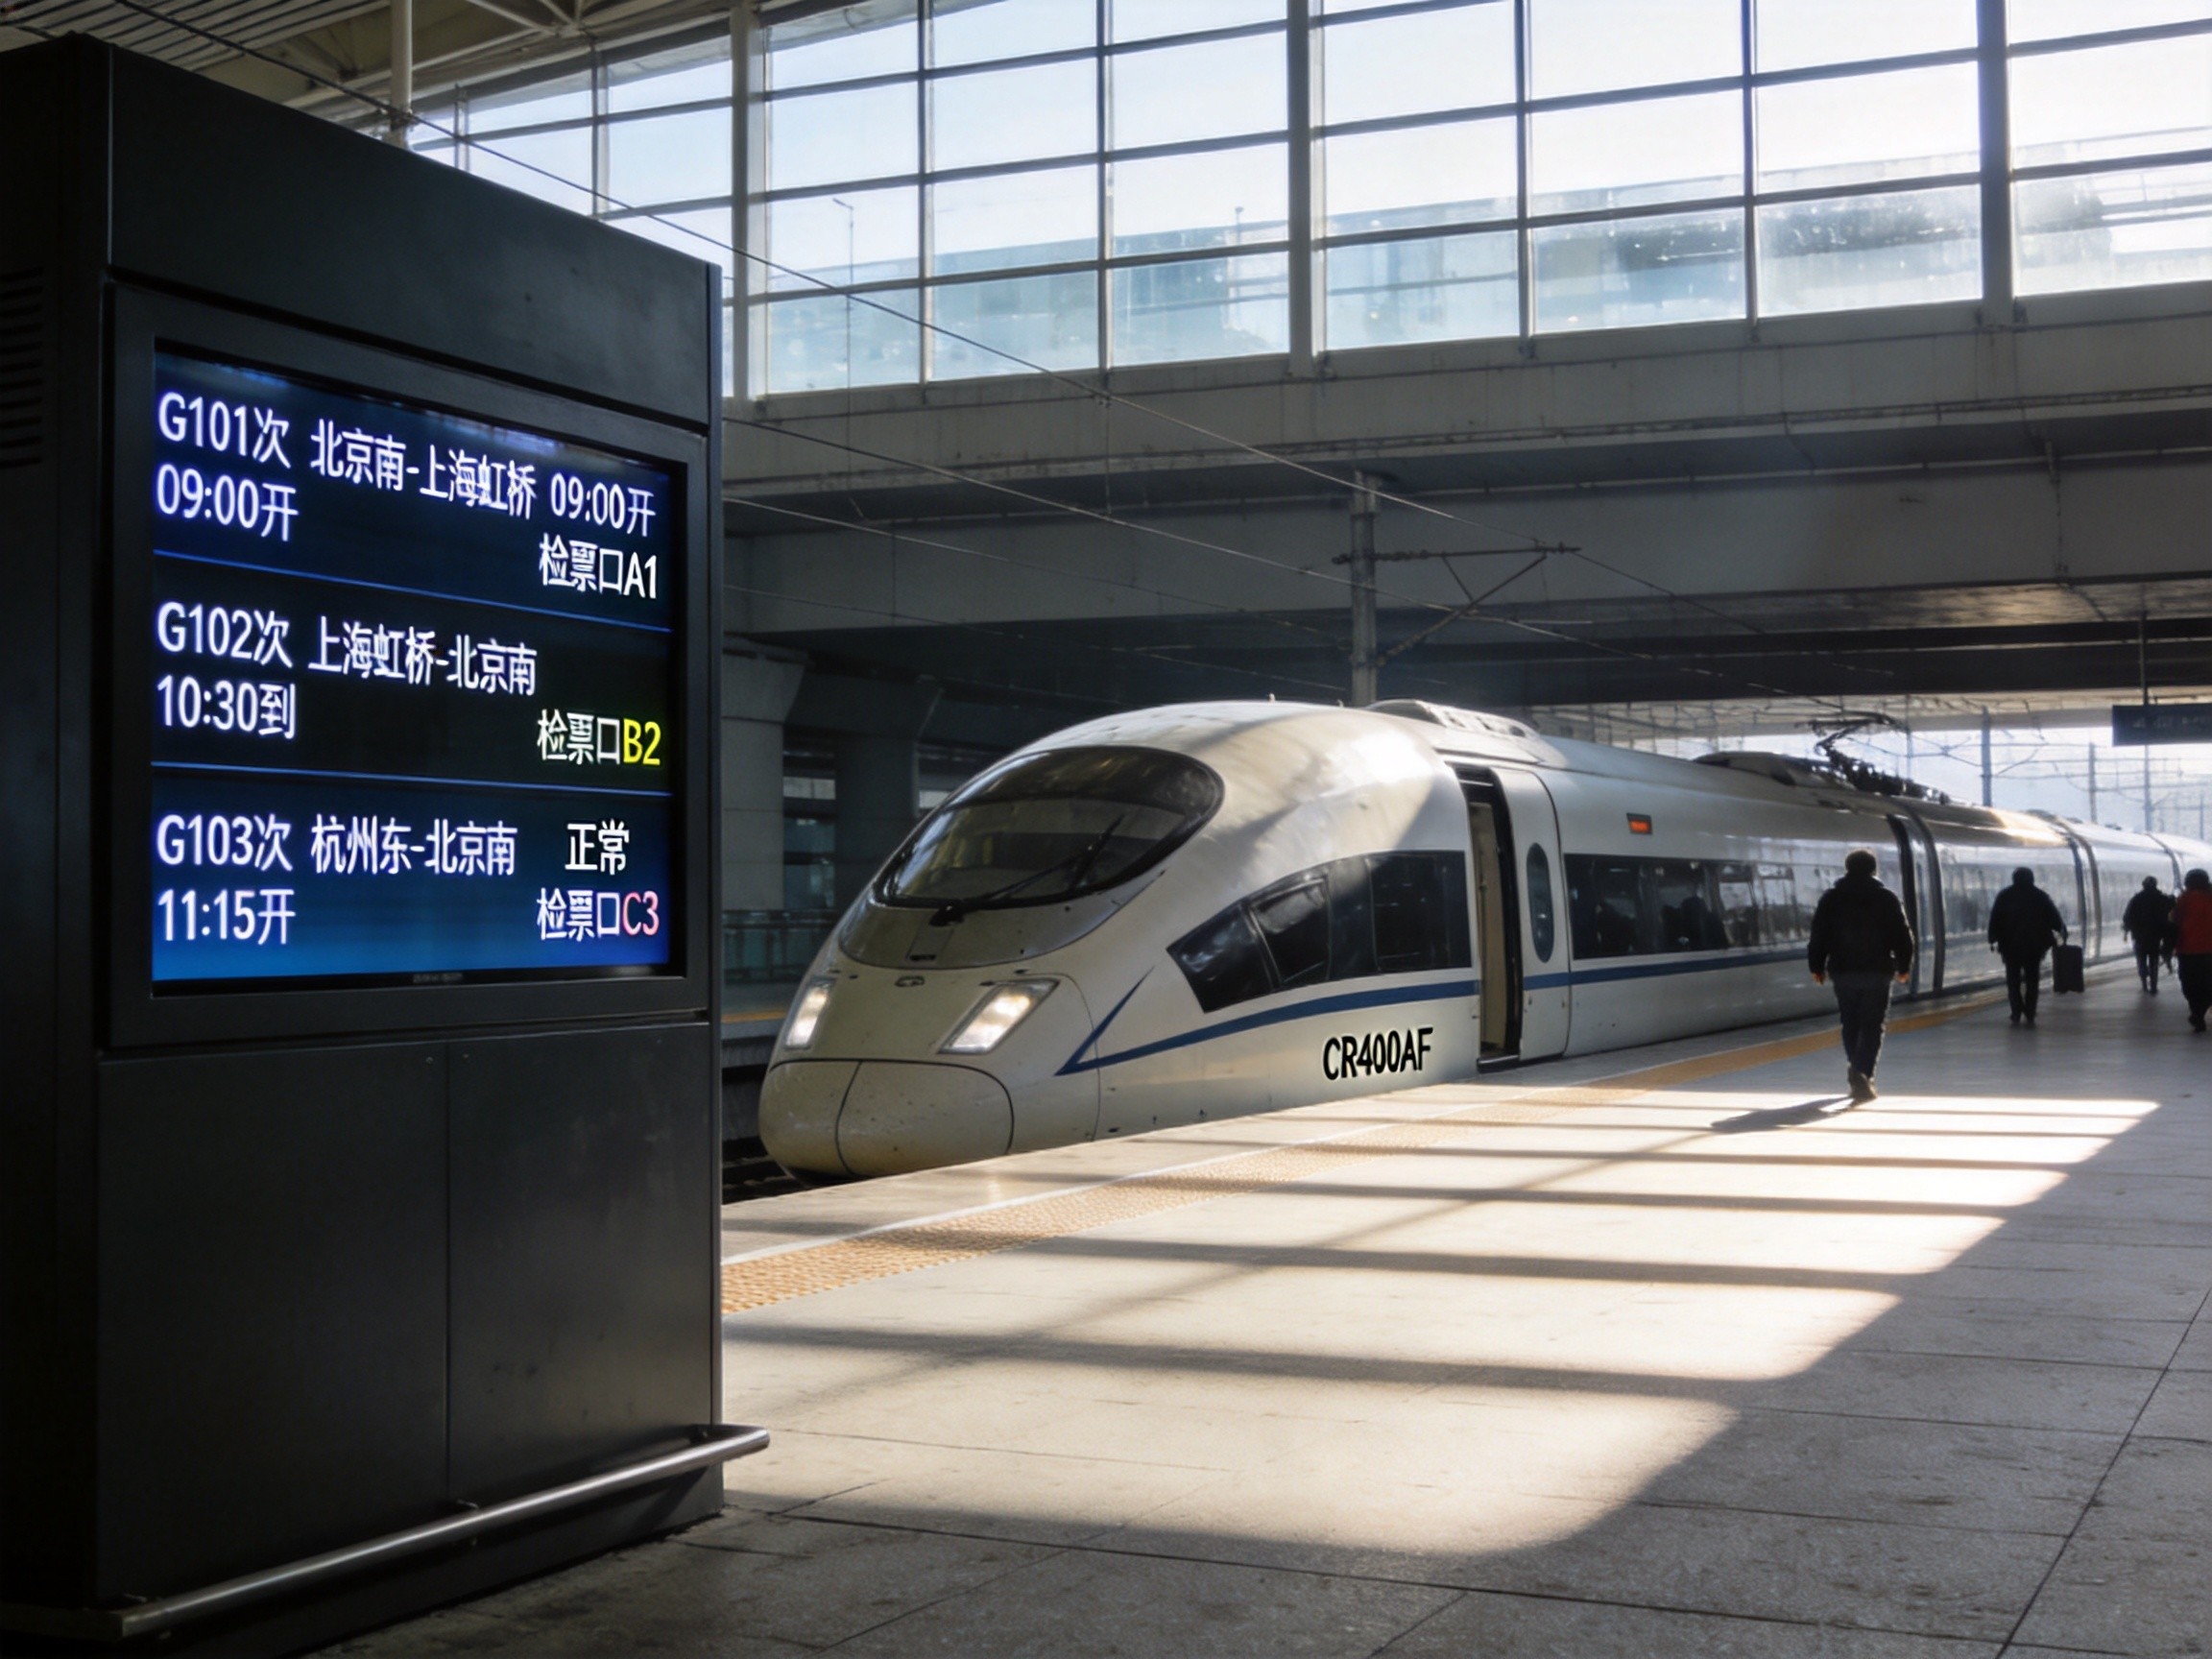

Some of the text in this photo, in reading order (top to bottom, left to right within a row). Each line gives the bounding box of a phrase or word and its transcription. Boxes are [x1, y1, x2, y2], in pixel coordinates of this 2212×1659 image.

[157, 392, 657, 538] G101次 北京南-上海虹桥 09:00开
[156, 463, 659, 600] 09:00开 检票口A1
[156, 601, 538, 696] G102次 上海虹桥-北京南
[156, 674, 662, 766] 10:30到 检票口B2
[156, 813, 630, 877] G103次 杭州东-北京南 正常
[157, 887, 661, 946] 11:15开 检票口C3
[1323, 1026, 1433, 1081] CR400AF
